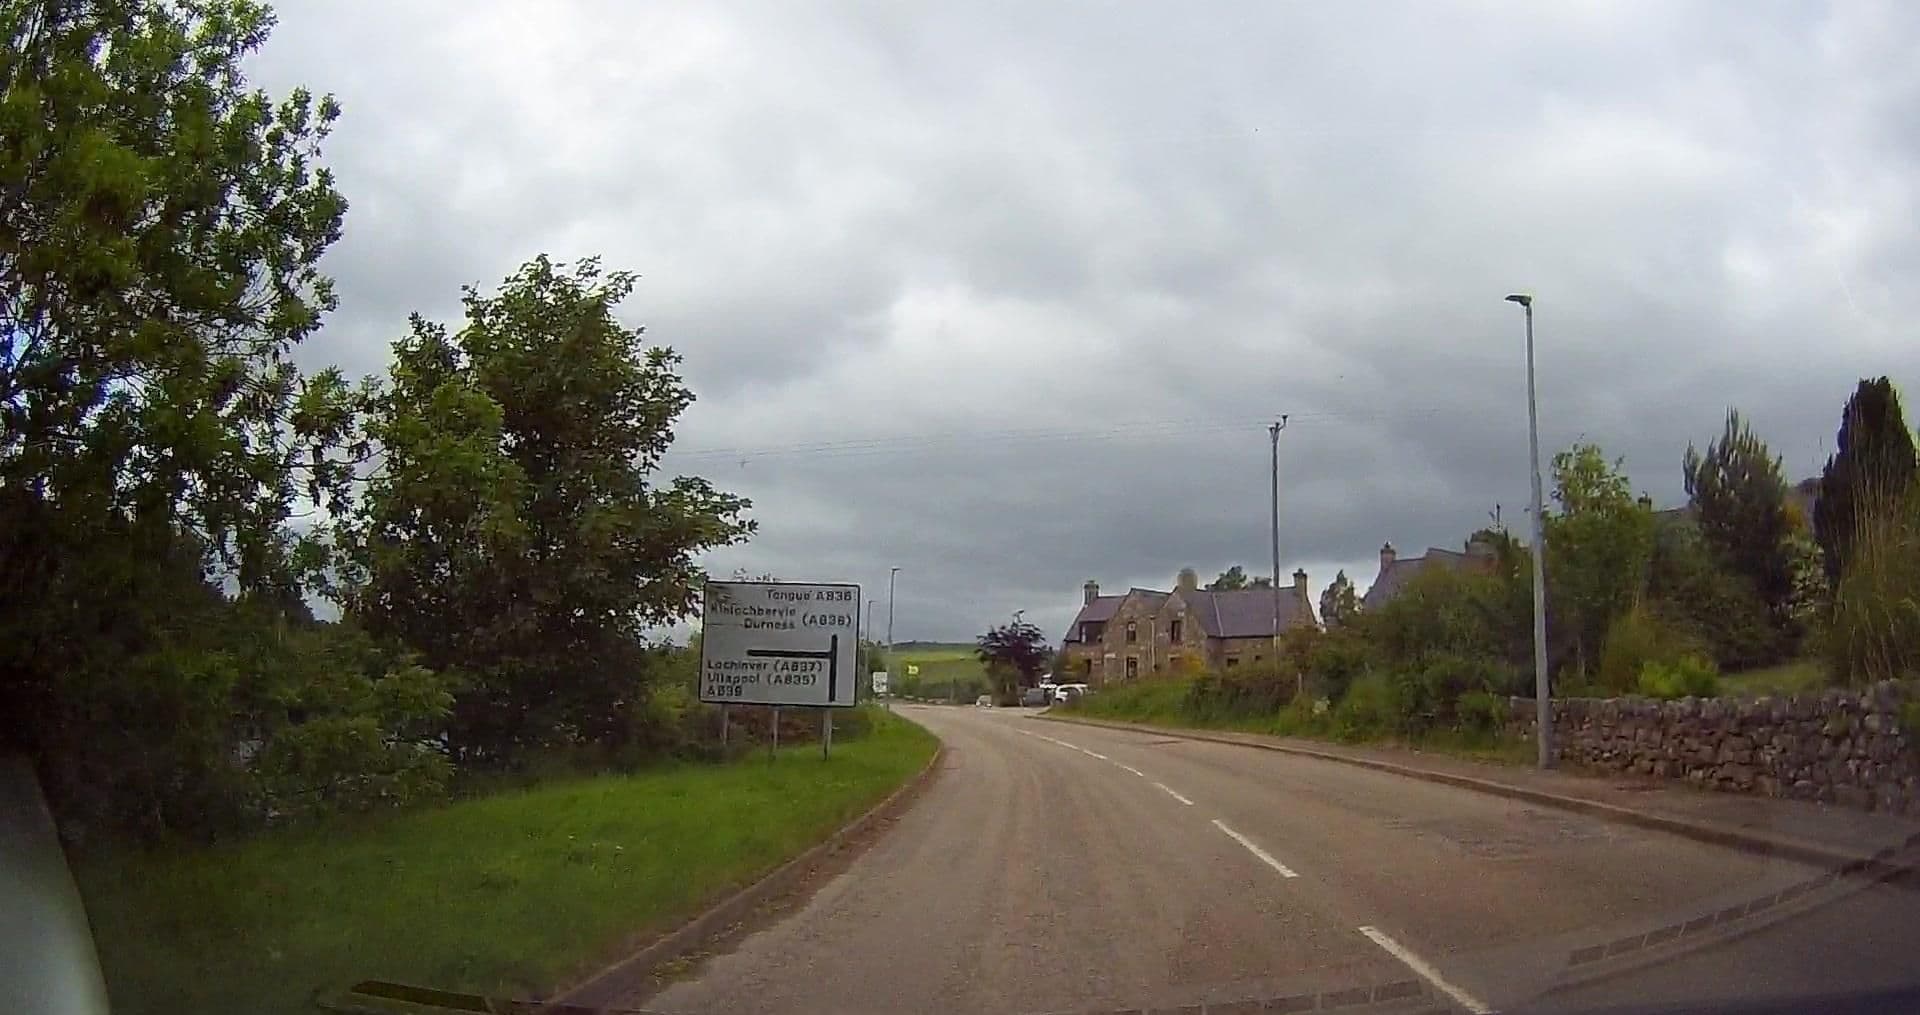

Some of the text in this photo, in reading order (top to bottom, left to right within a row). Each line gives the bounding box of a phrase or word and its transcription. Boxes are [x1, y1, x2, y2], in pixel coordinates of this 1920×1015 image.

[767, 589, 811, 602] Tongue
[744, 617, 795, 630] Durness
[707, 660, 823, 673] Lochinver (A837)
[707, 673, 816, 686] Ullapool (A835)
[707, 686, 743, 697] A839
